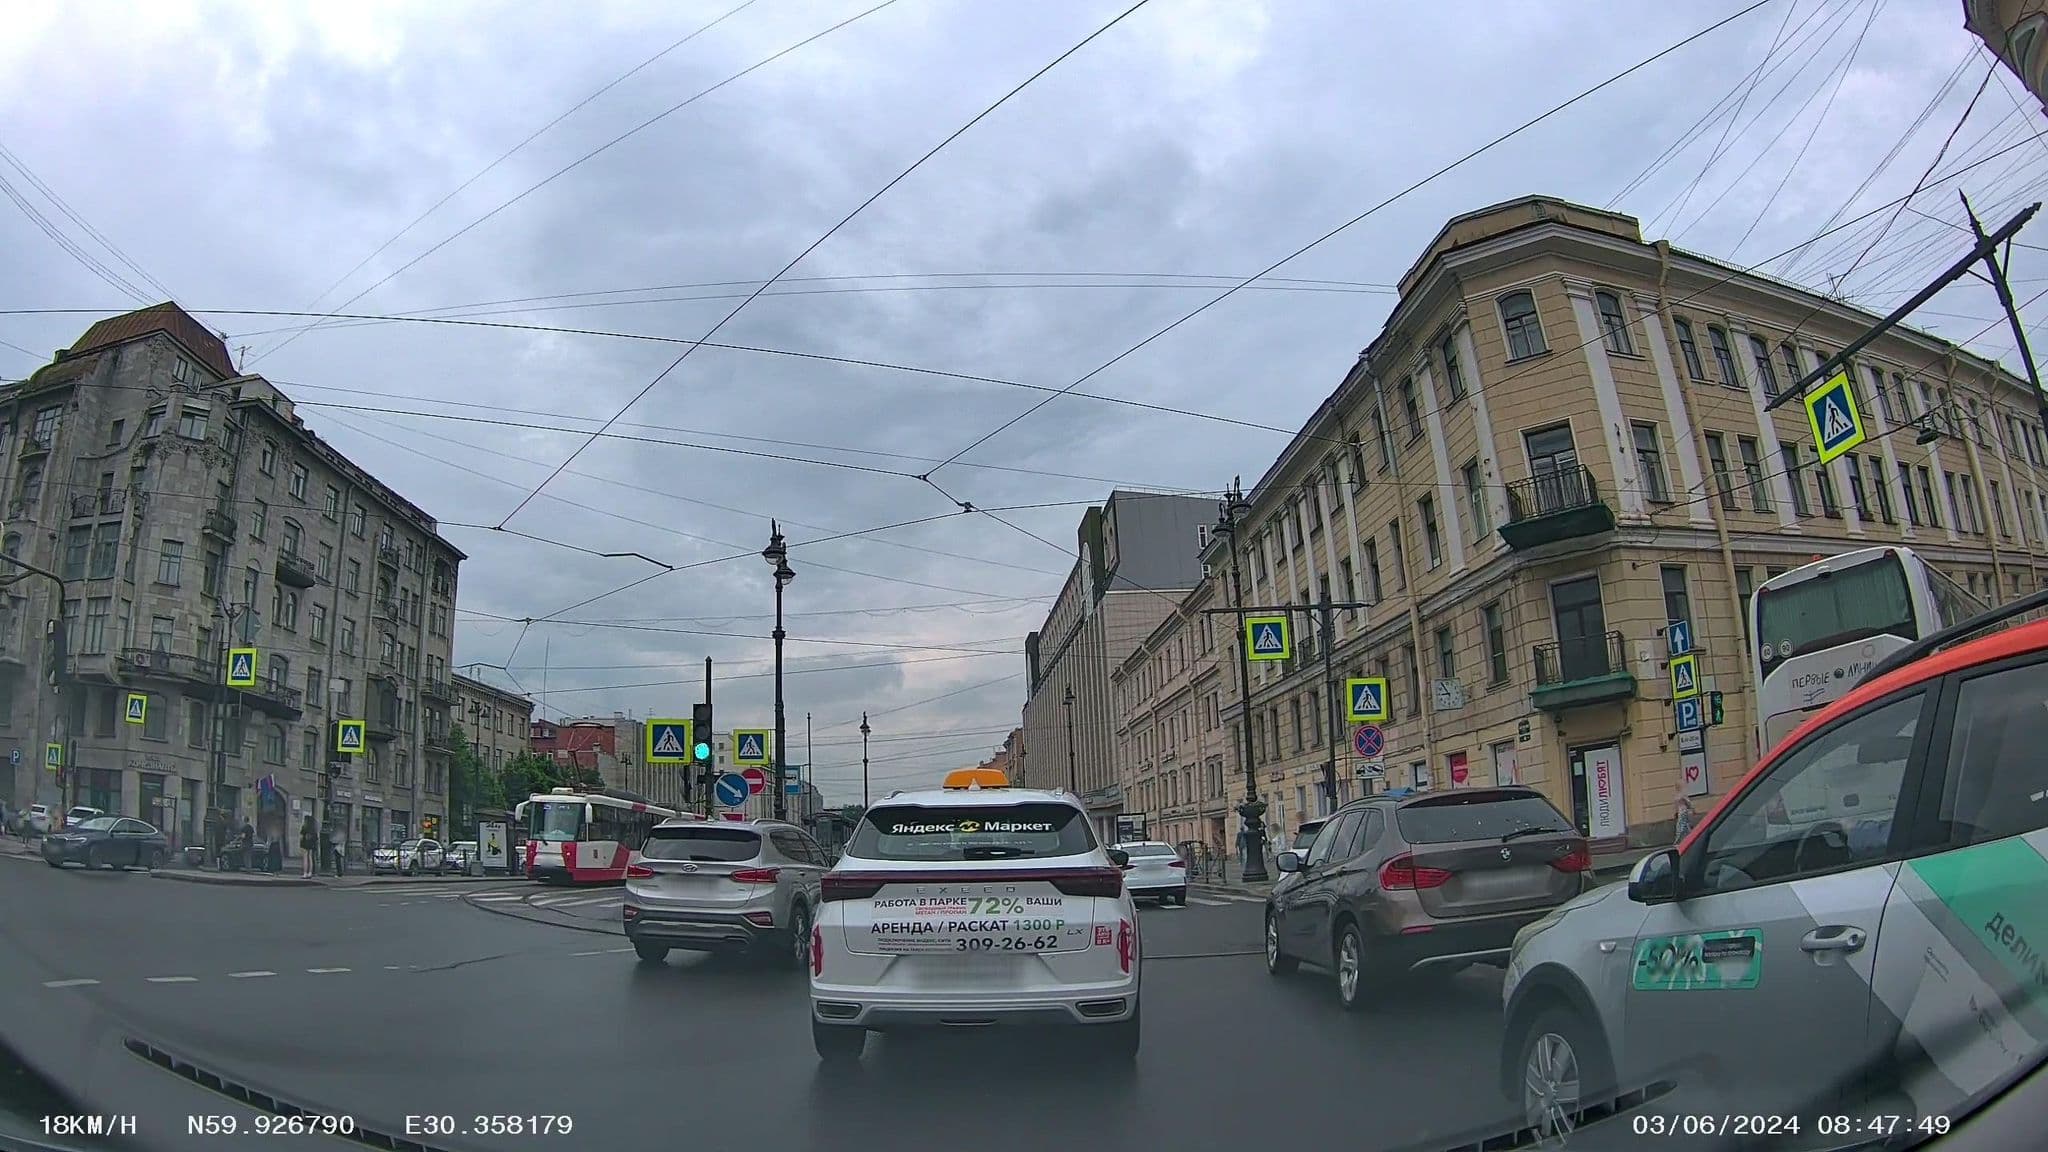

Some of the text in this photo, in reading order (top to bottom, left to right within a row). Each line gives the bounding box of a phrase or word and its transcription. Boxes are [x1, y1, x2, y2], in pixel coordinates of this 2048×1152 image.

[891, 821, 1052, 834] Яндекс Маркет
[874, 899, 917, 908] РАБОТА
[919, 898, 926, 906] В
[929, 897, 967, 906] ПАРКЕ
[968, 897, 1024, 914] 72%
[1026, 897, 1062, 906] ВАШИ
[871, 921, 934, 935] АРЕНДА
[937, 921, 944, 933] /
[948, 920, 1008, 932] РАСКАТ
[1013, 919, 1051, 931] 1300
[956, 935, 1058, 952] 309-26-62
